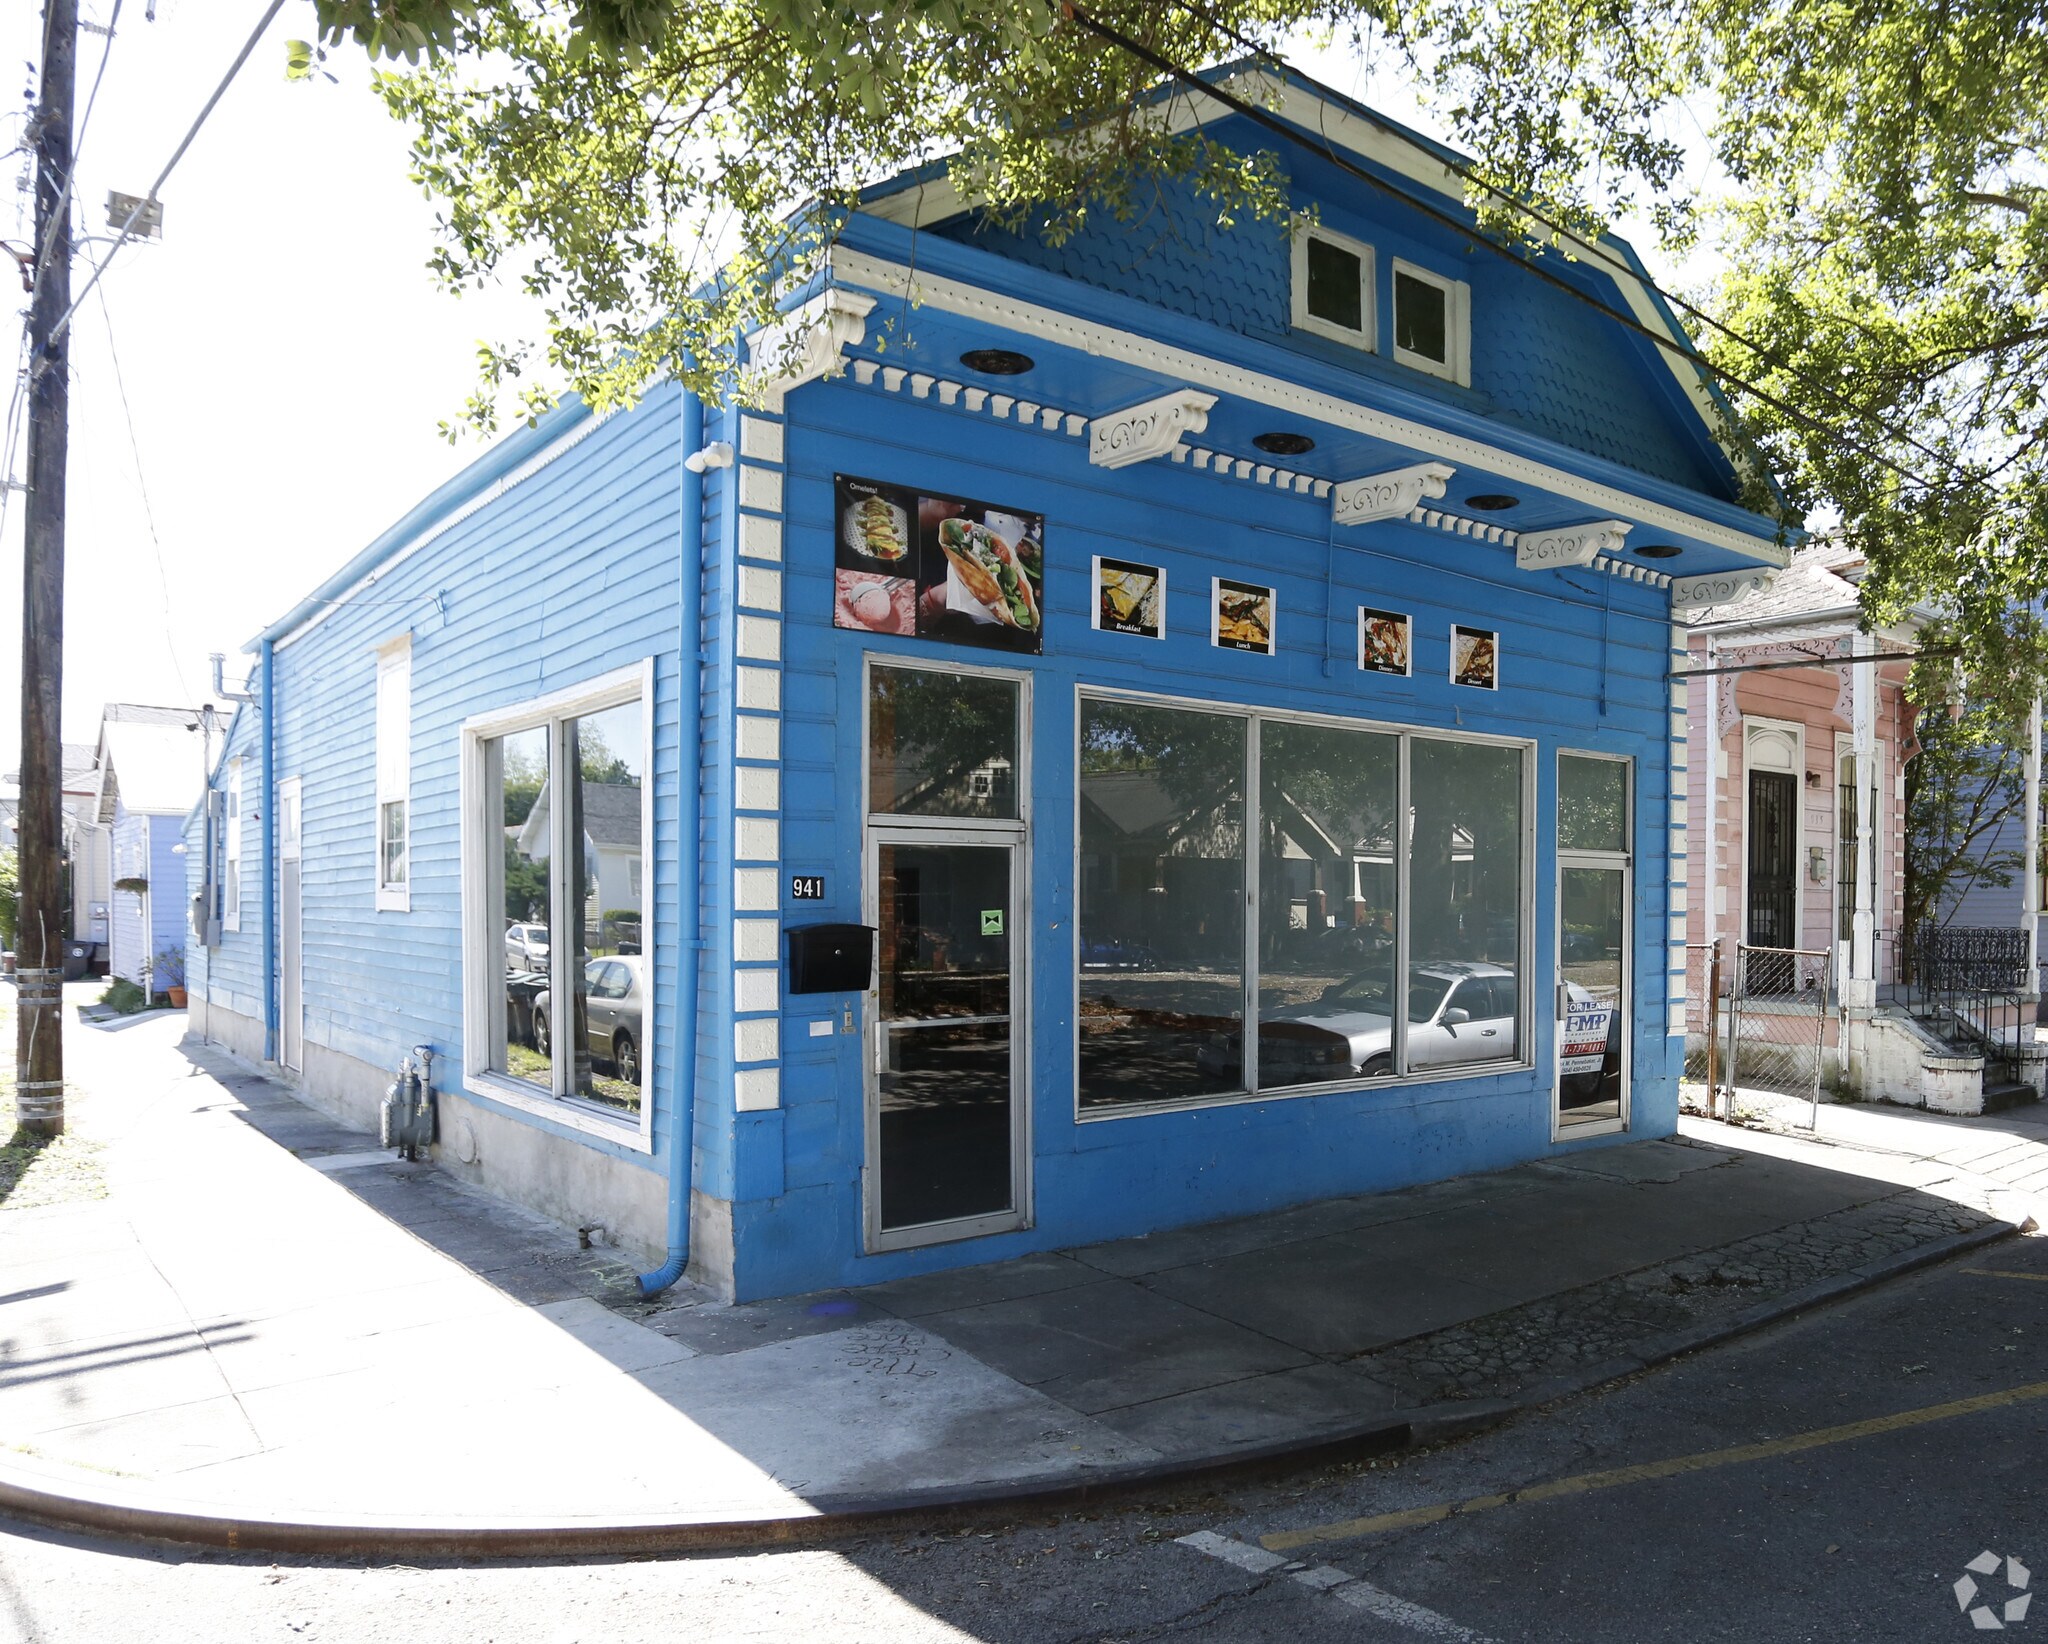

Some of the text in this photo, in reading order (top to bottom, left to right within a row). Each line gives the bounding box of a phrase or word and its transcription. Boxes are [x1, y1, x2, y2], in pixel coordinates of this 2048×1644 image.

[1115, 622, 1142, 633] Breakfast
[1236, 641, 1251, 650] Lunch
[1378, 664, 1393, 673] Dinner
[793, 878, 821, 897] 941
[1584, 1001, 1612, 1011] LEASE
[1565, 1013, 1607, 1032] FMP
